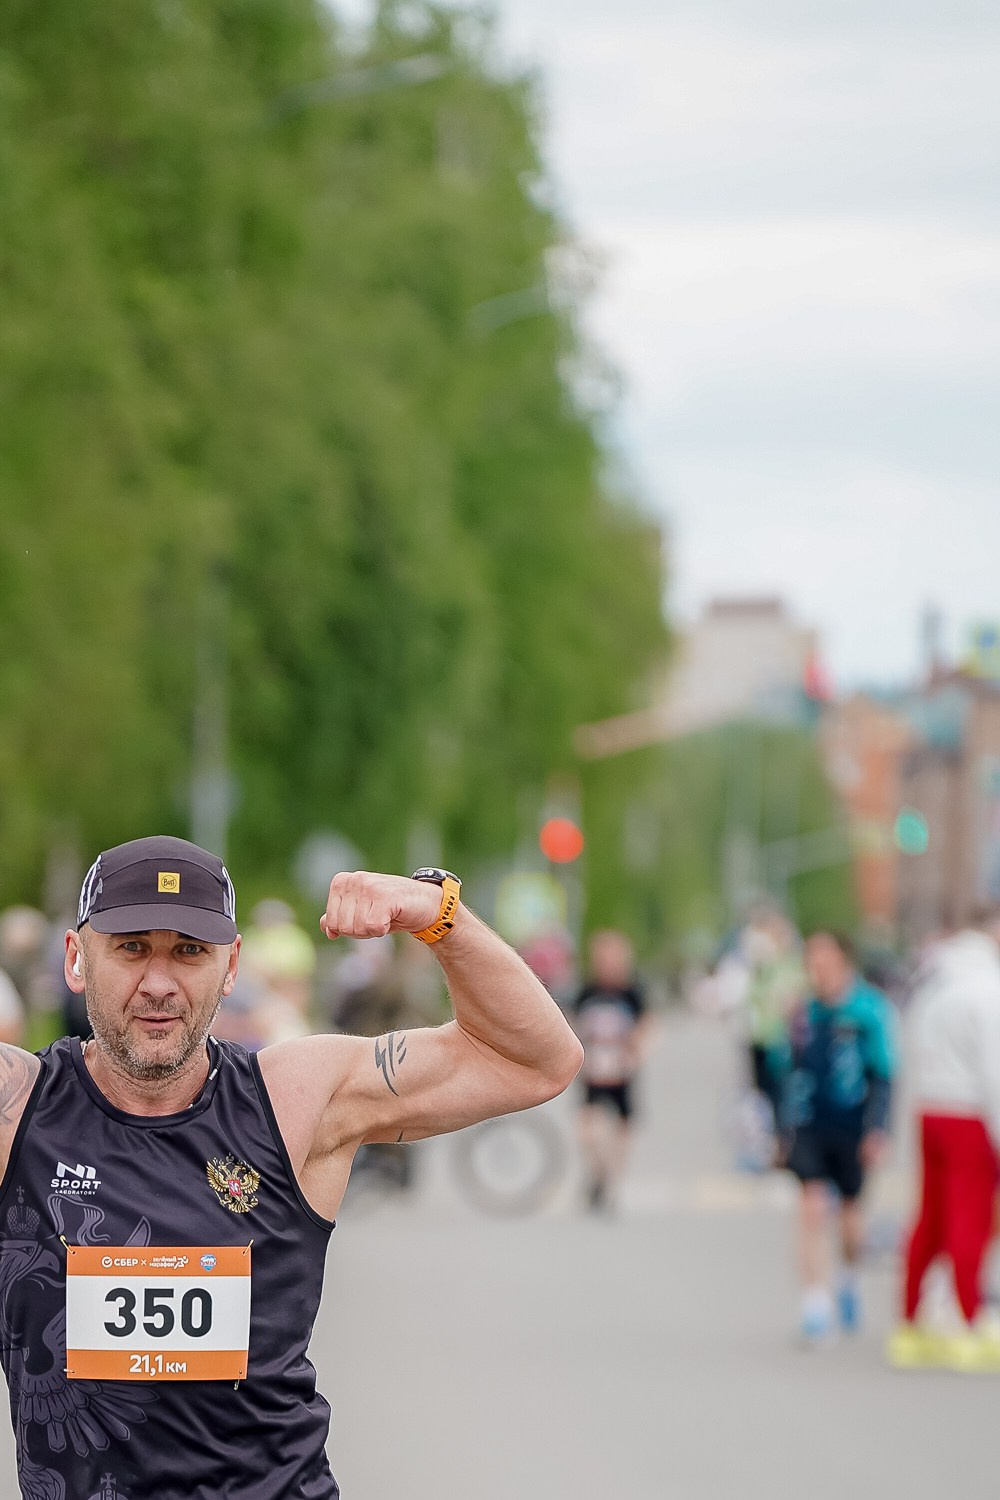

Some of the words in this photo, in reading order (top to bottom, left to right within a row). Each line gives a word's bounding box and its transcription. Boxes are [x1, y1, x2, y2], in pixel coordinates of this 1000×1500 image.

[51, 1179, 101, 1189] SPORT
[113, 1257, 139, 1267] СБЕР
[103, 1287, 213, 1338] 350
[129, 1354, 163, 1377] 21,1
